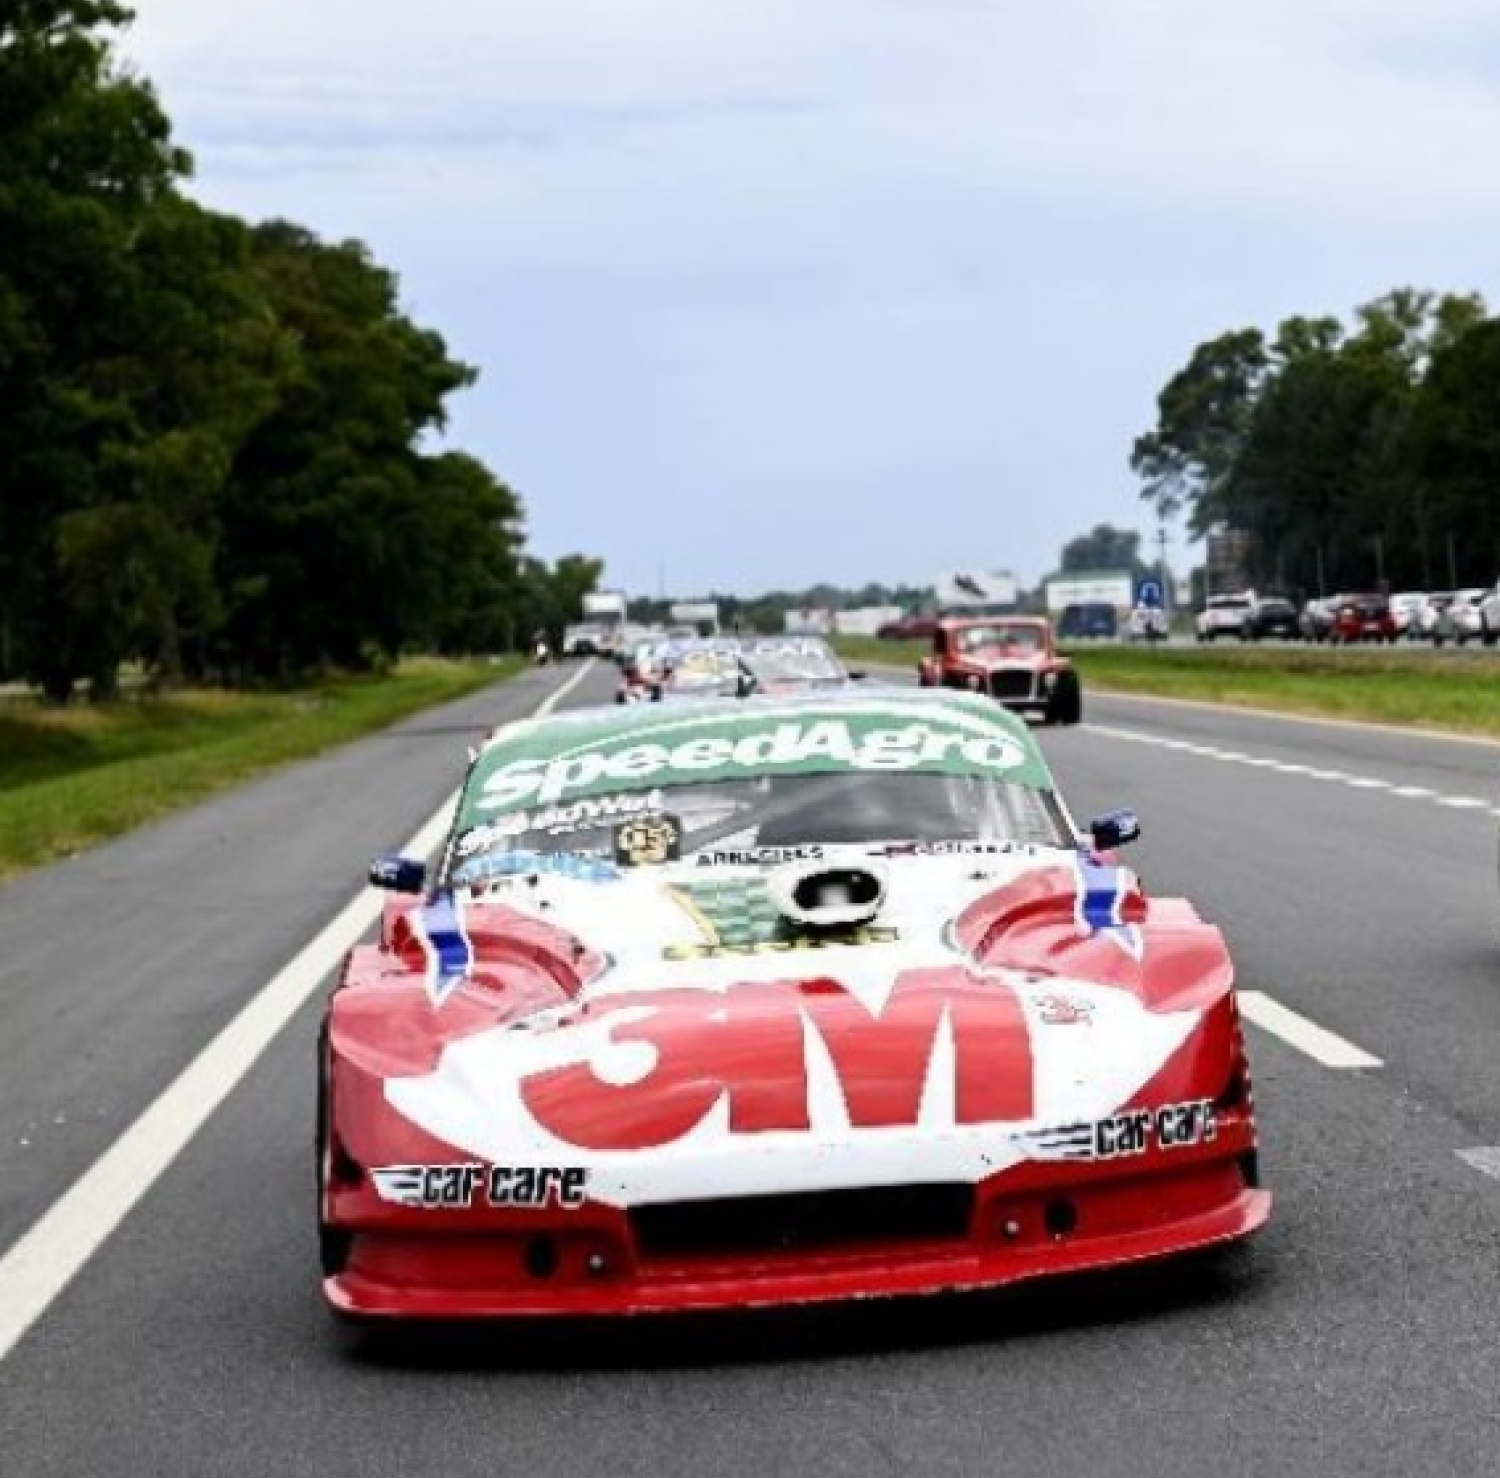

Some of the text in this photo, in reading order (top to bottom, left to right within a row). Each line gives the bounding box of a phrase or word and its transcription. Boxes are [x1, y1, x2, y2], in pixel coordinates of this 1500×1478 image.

[479, 720, 1026, 810] SpeedAgro
[519, 967, 1035, 1151] 3M
[1096, 1111, 1150, 1156] car
[423, 1165, 586, 1207] car care
